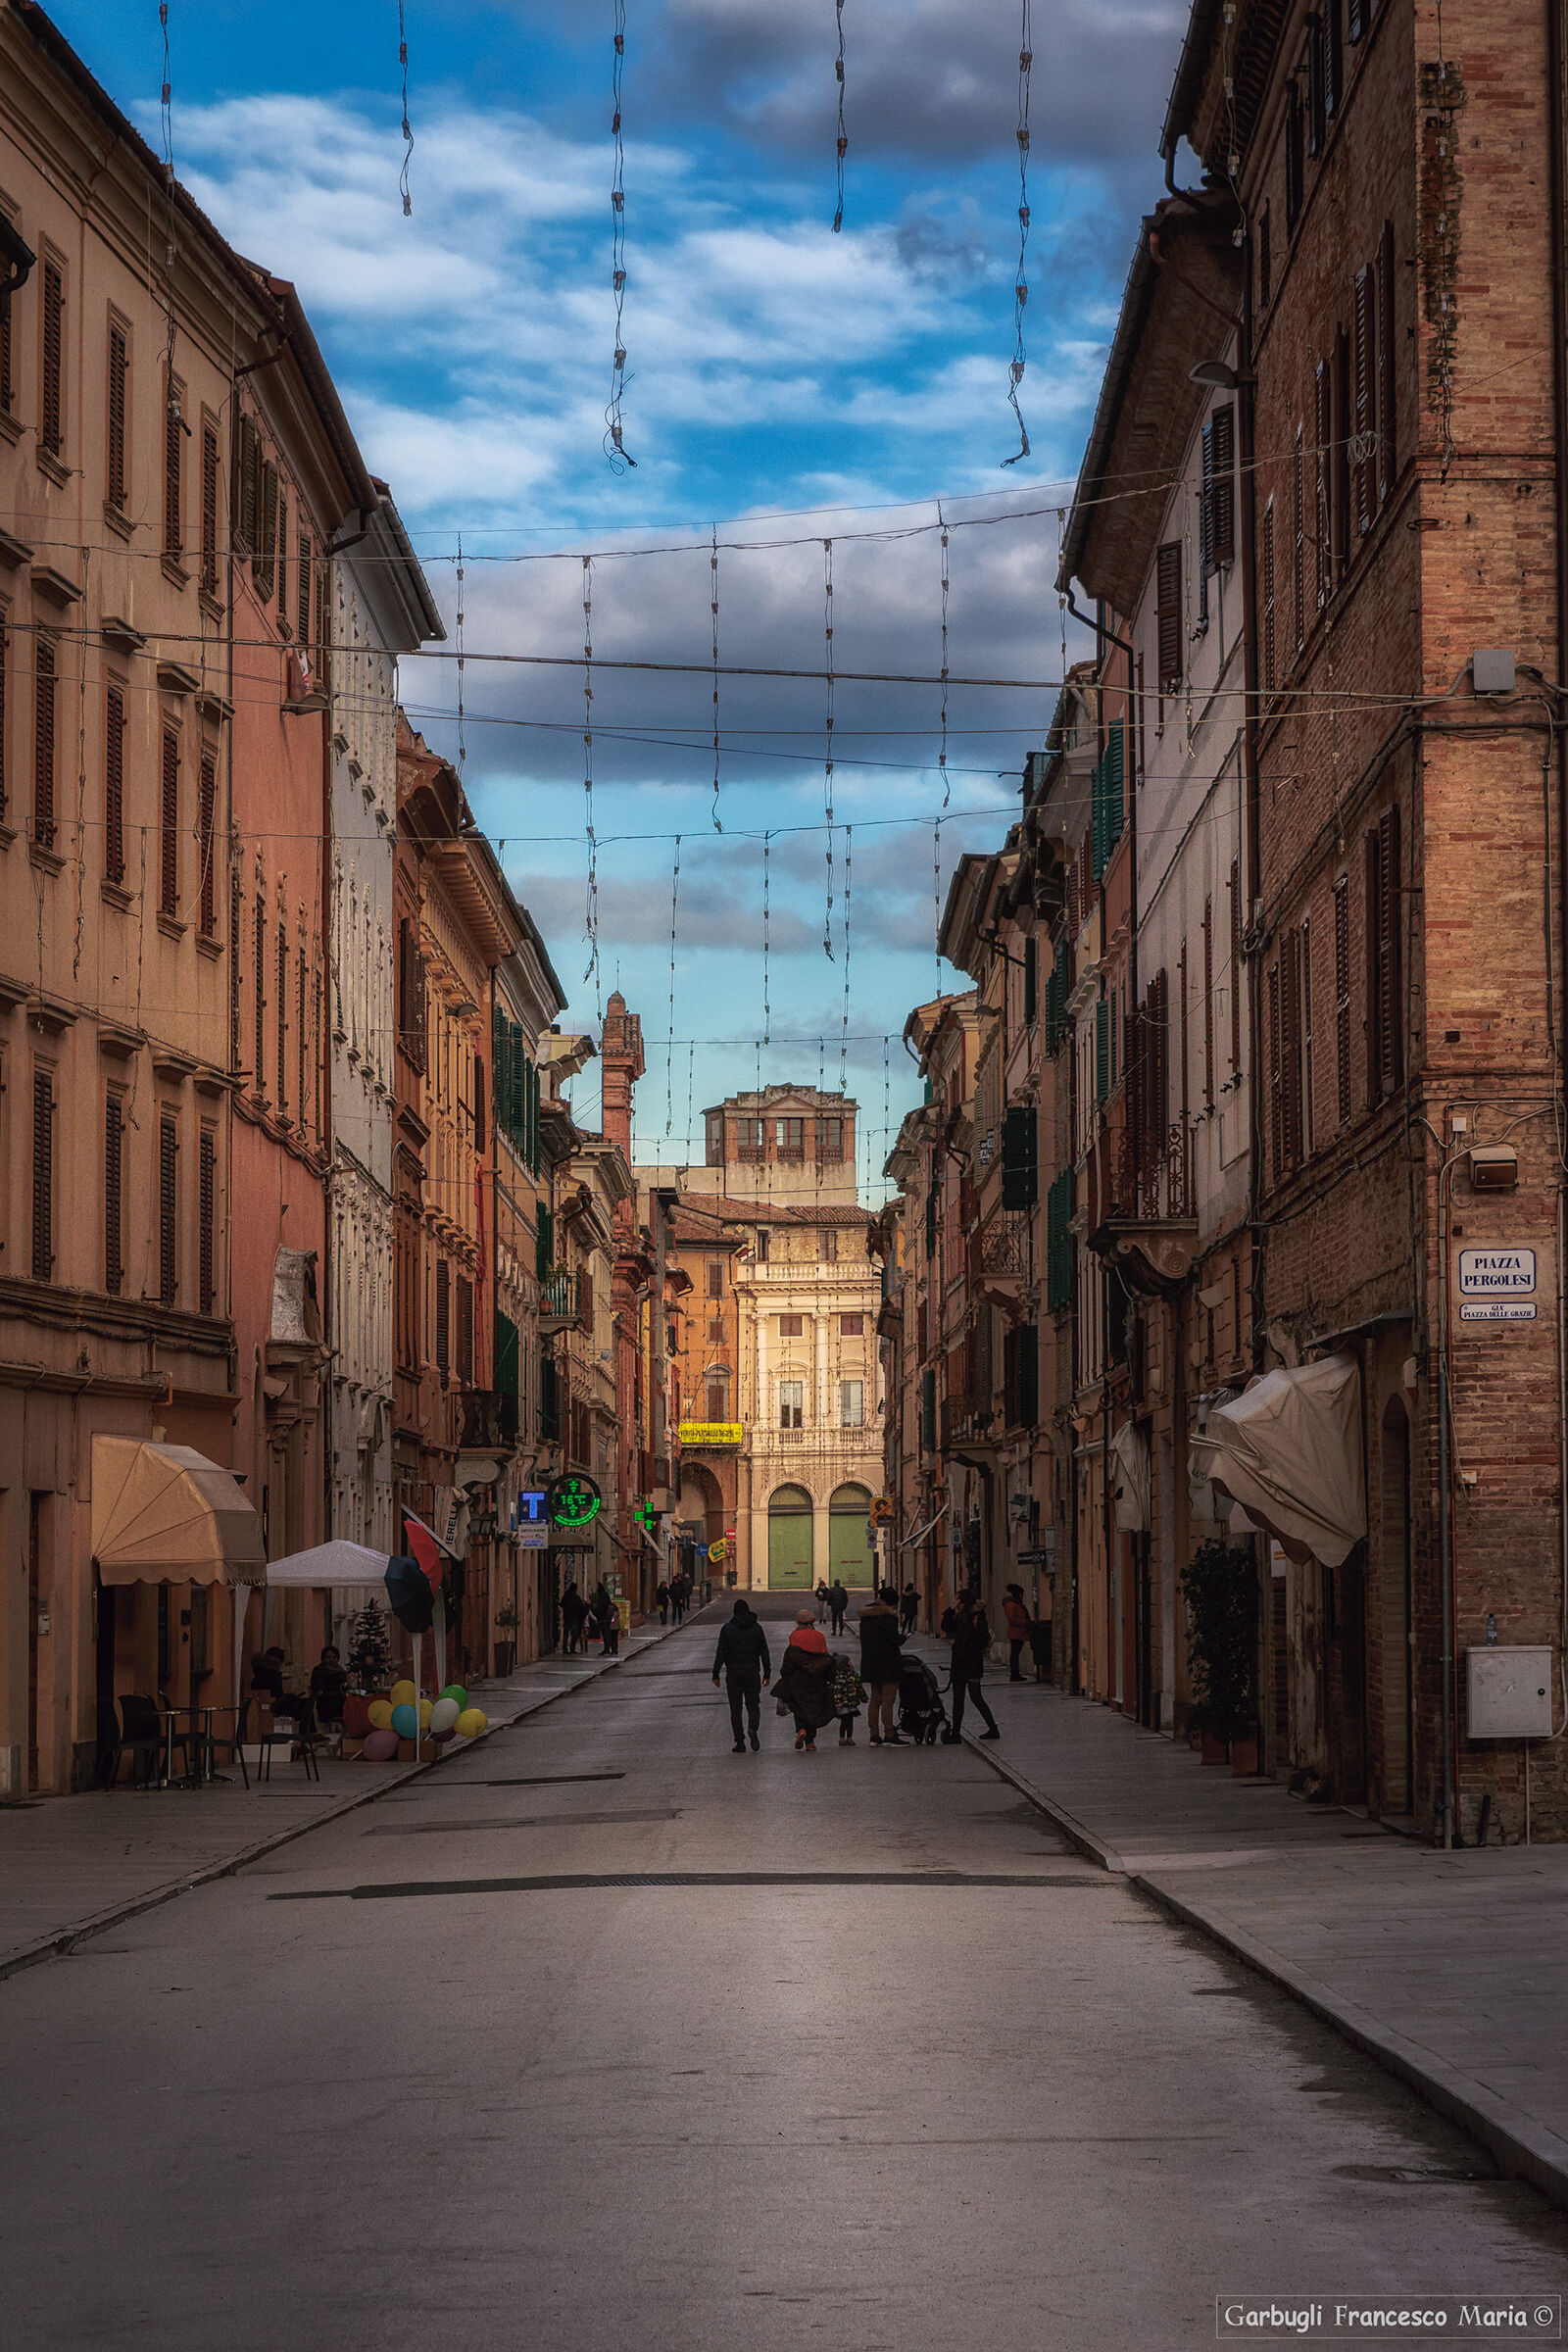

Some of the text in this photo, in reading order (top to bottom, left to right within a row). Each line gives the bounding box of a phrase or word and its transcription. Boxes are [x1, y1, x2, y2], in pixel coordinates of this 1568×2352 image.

[1474, 1257, 1521, 1269] PIAZZA
[1464, 1274, 1531, 1287] PERGOLESI
[522, 1493, 545, 1519] T
